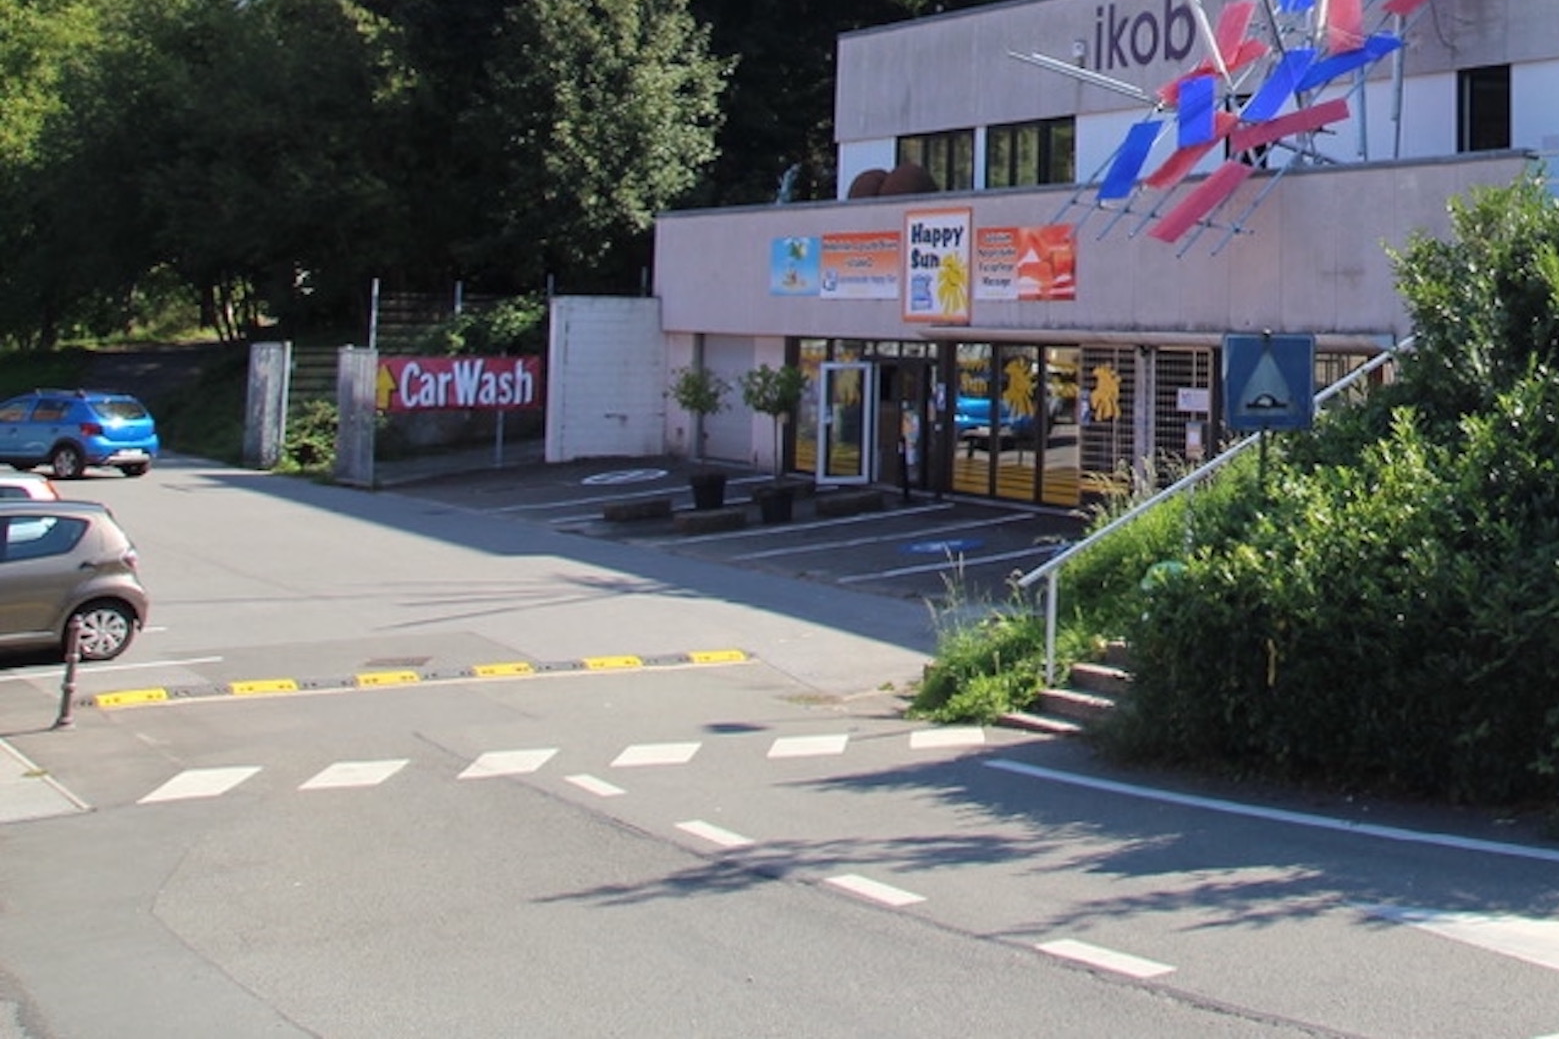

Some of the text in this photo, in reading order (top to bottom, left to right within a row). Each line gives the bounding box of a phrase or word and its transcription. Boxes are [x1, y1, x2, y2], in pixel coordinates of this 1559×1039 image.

[911, 222, 964, 248] Happy
[911, 248, 940, 269] Sun
[400, 358, 533, 408] CarWash
